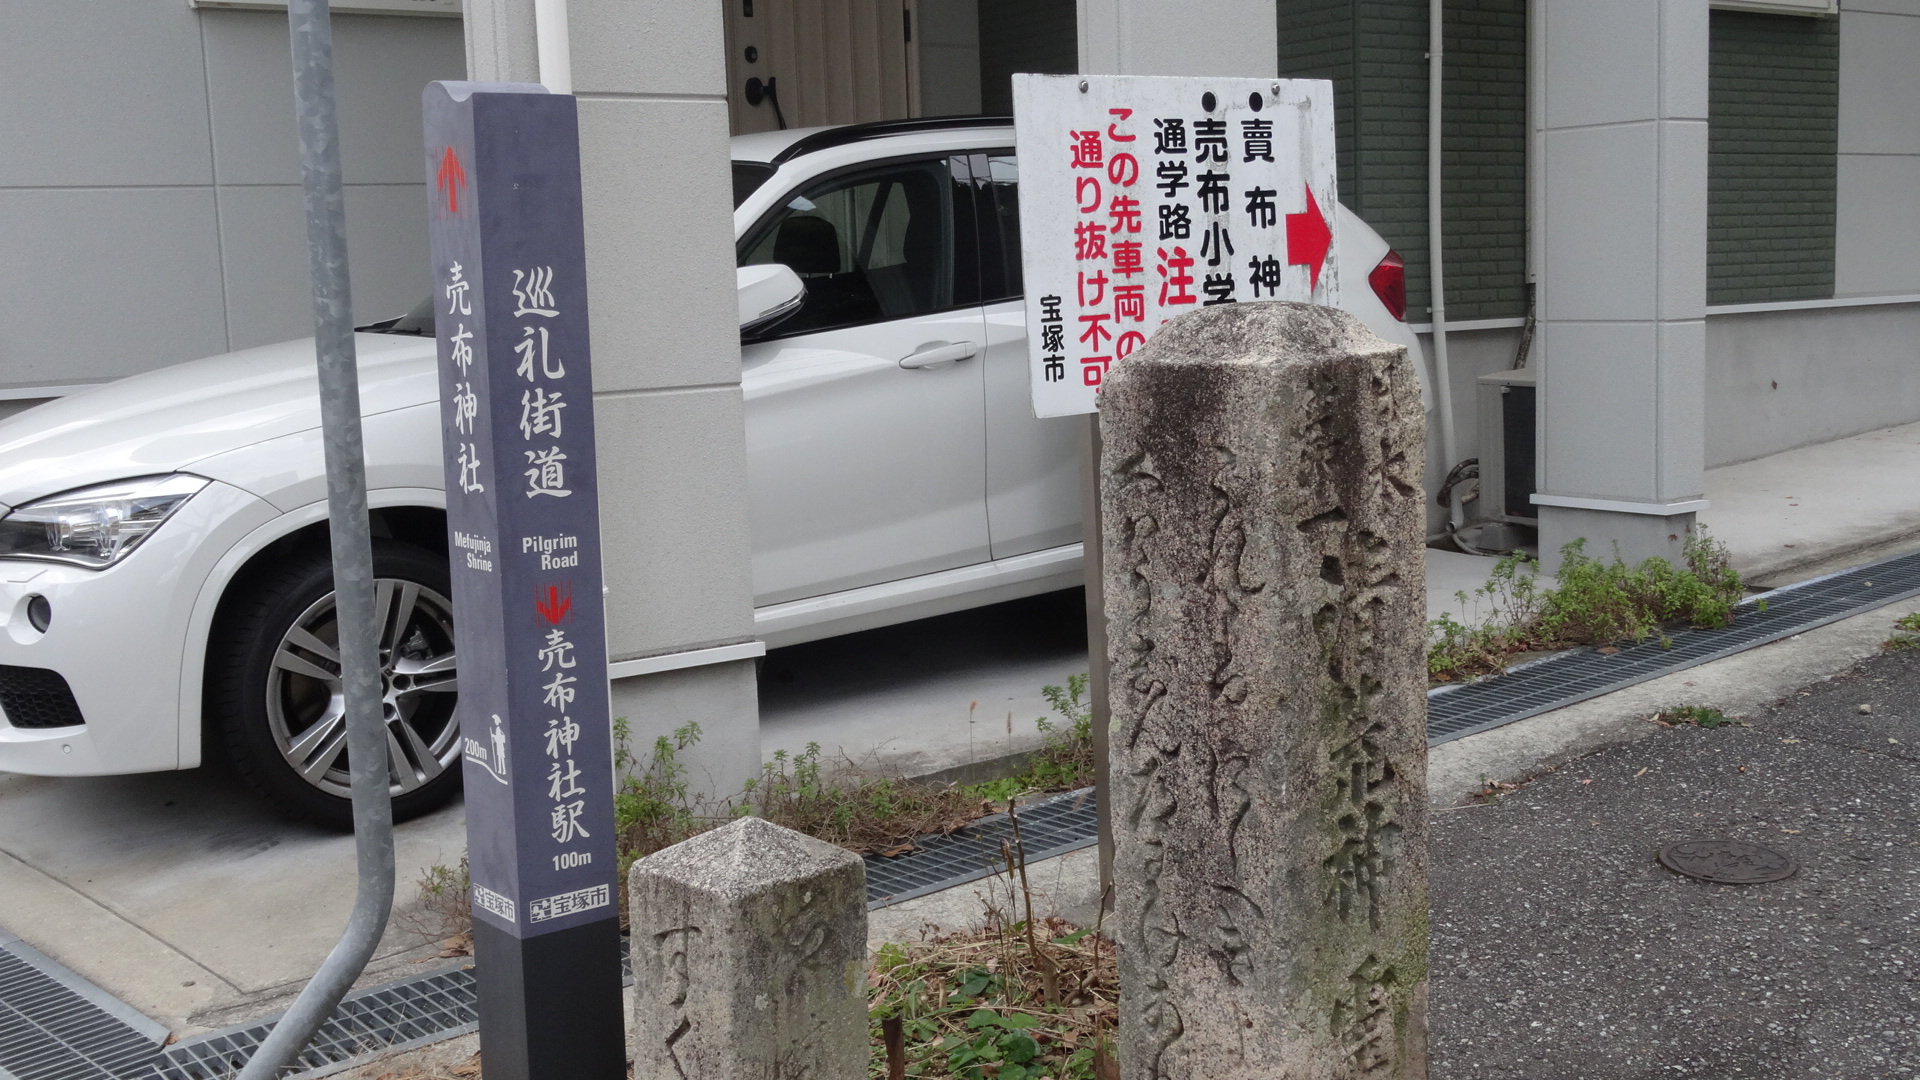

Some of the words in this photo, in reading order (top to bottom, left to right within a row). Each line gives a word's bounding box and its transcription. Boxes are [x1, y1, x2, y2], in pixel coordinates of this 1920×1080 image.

[1069, 130, 1113, 394] 通り抜け不可
[1040, 294, 1066, 383] 宝塚市
[446, 260, 484, 495] 売布神社
[512, 265, 572, 499] 巡礼街道
[454, 531, 492, 554] Mefujinja
[522, 533, 578, 555] Pilgrim
[466, 552, 493, 573] Shrine
[541, 551, 579, 571] Road
[464, 737, 487, 761] 200m
[537, 629, 590, 844] 売布神社駅
[552, 851, 592, 872] 100m
[484, 884, 515, 923] 宝塚市
[551, 884, 609, 918] 宝塚市
